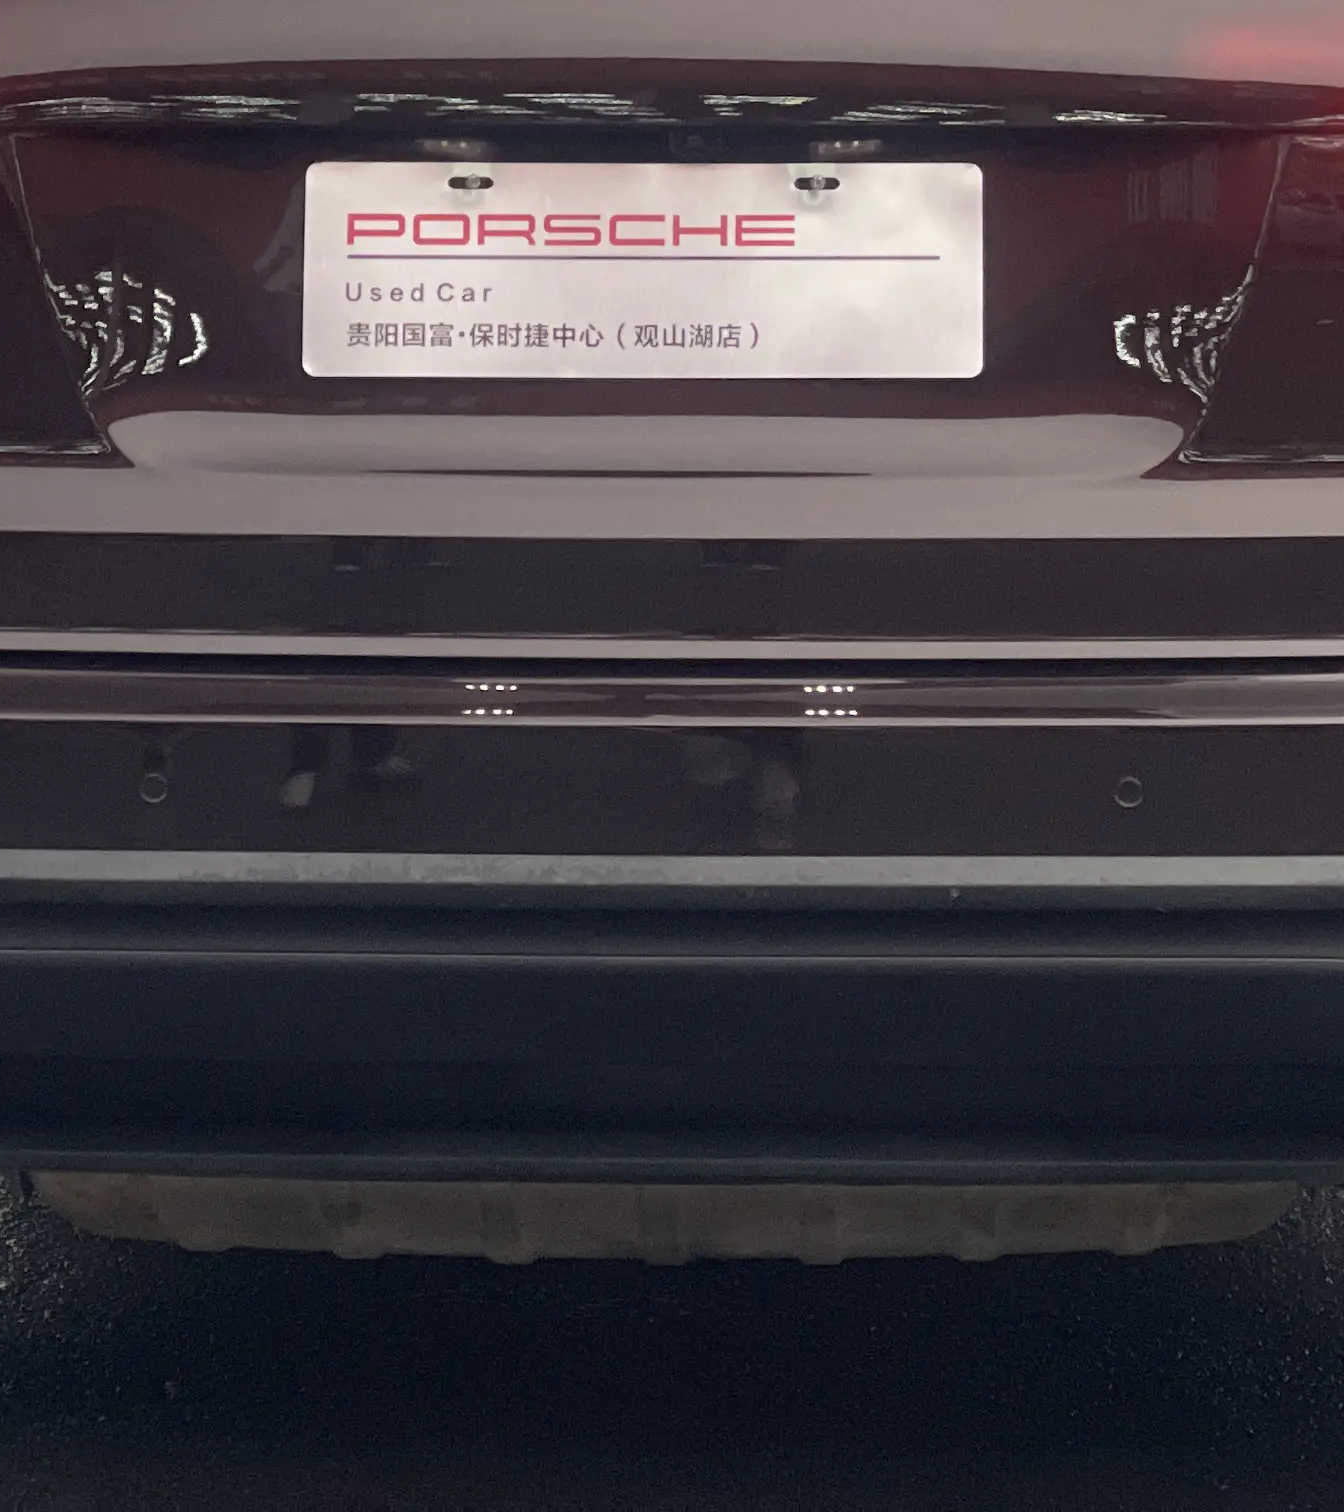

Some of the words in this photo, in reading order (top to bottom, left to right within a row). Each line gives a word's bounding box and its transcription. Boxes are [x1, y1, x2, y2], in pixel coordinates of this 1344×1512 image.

[346, 212, 796, 248] PORSCHE
[345, 282, 426, 303] Used
[436, 282, 493, 303] Car
